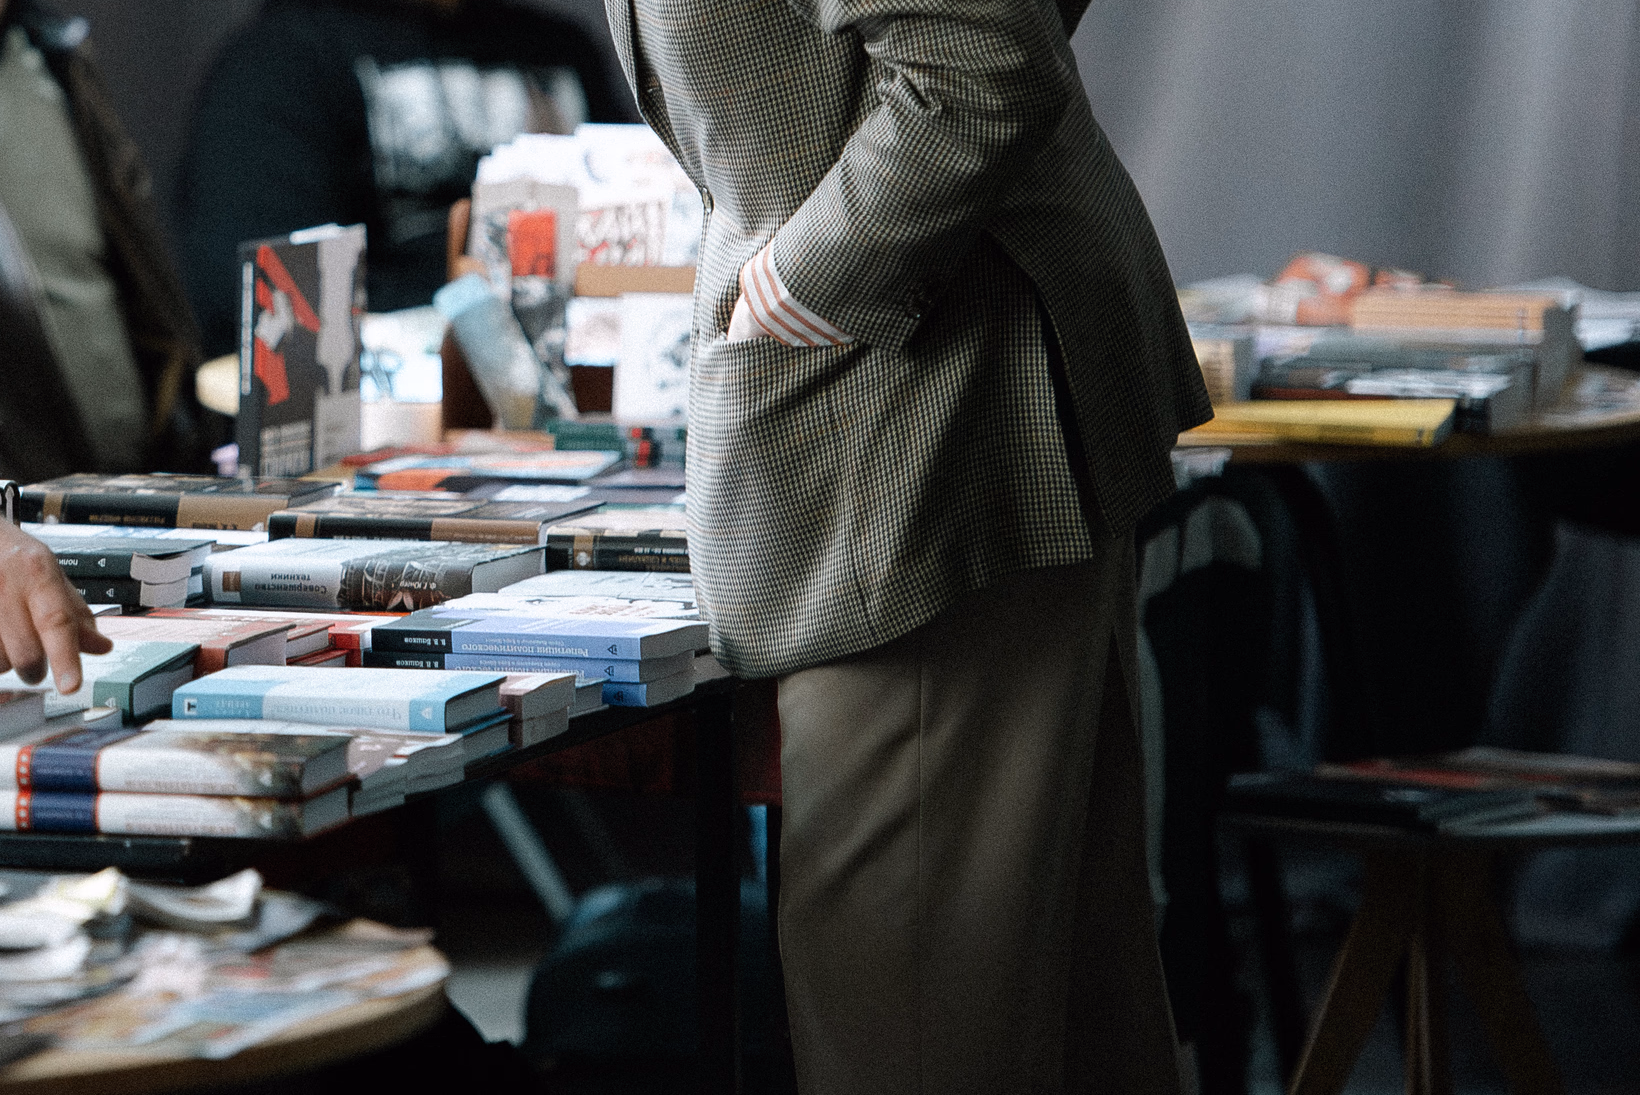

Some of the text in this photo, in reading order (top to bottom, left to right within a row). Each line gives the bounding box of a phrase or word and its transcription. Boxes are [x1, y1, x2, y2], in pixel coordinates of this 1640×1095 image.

[271, 573, 311, 582] техники
[255, 581, 327, 594] Совершенство
[462, 644, 588, 656] Репетиция политического
